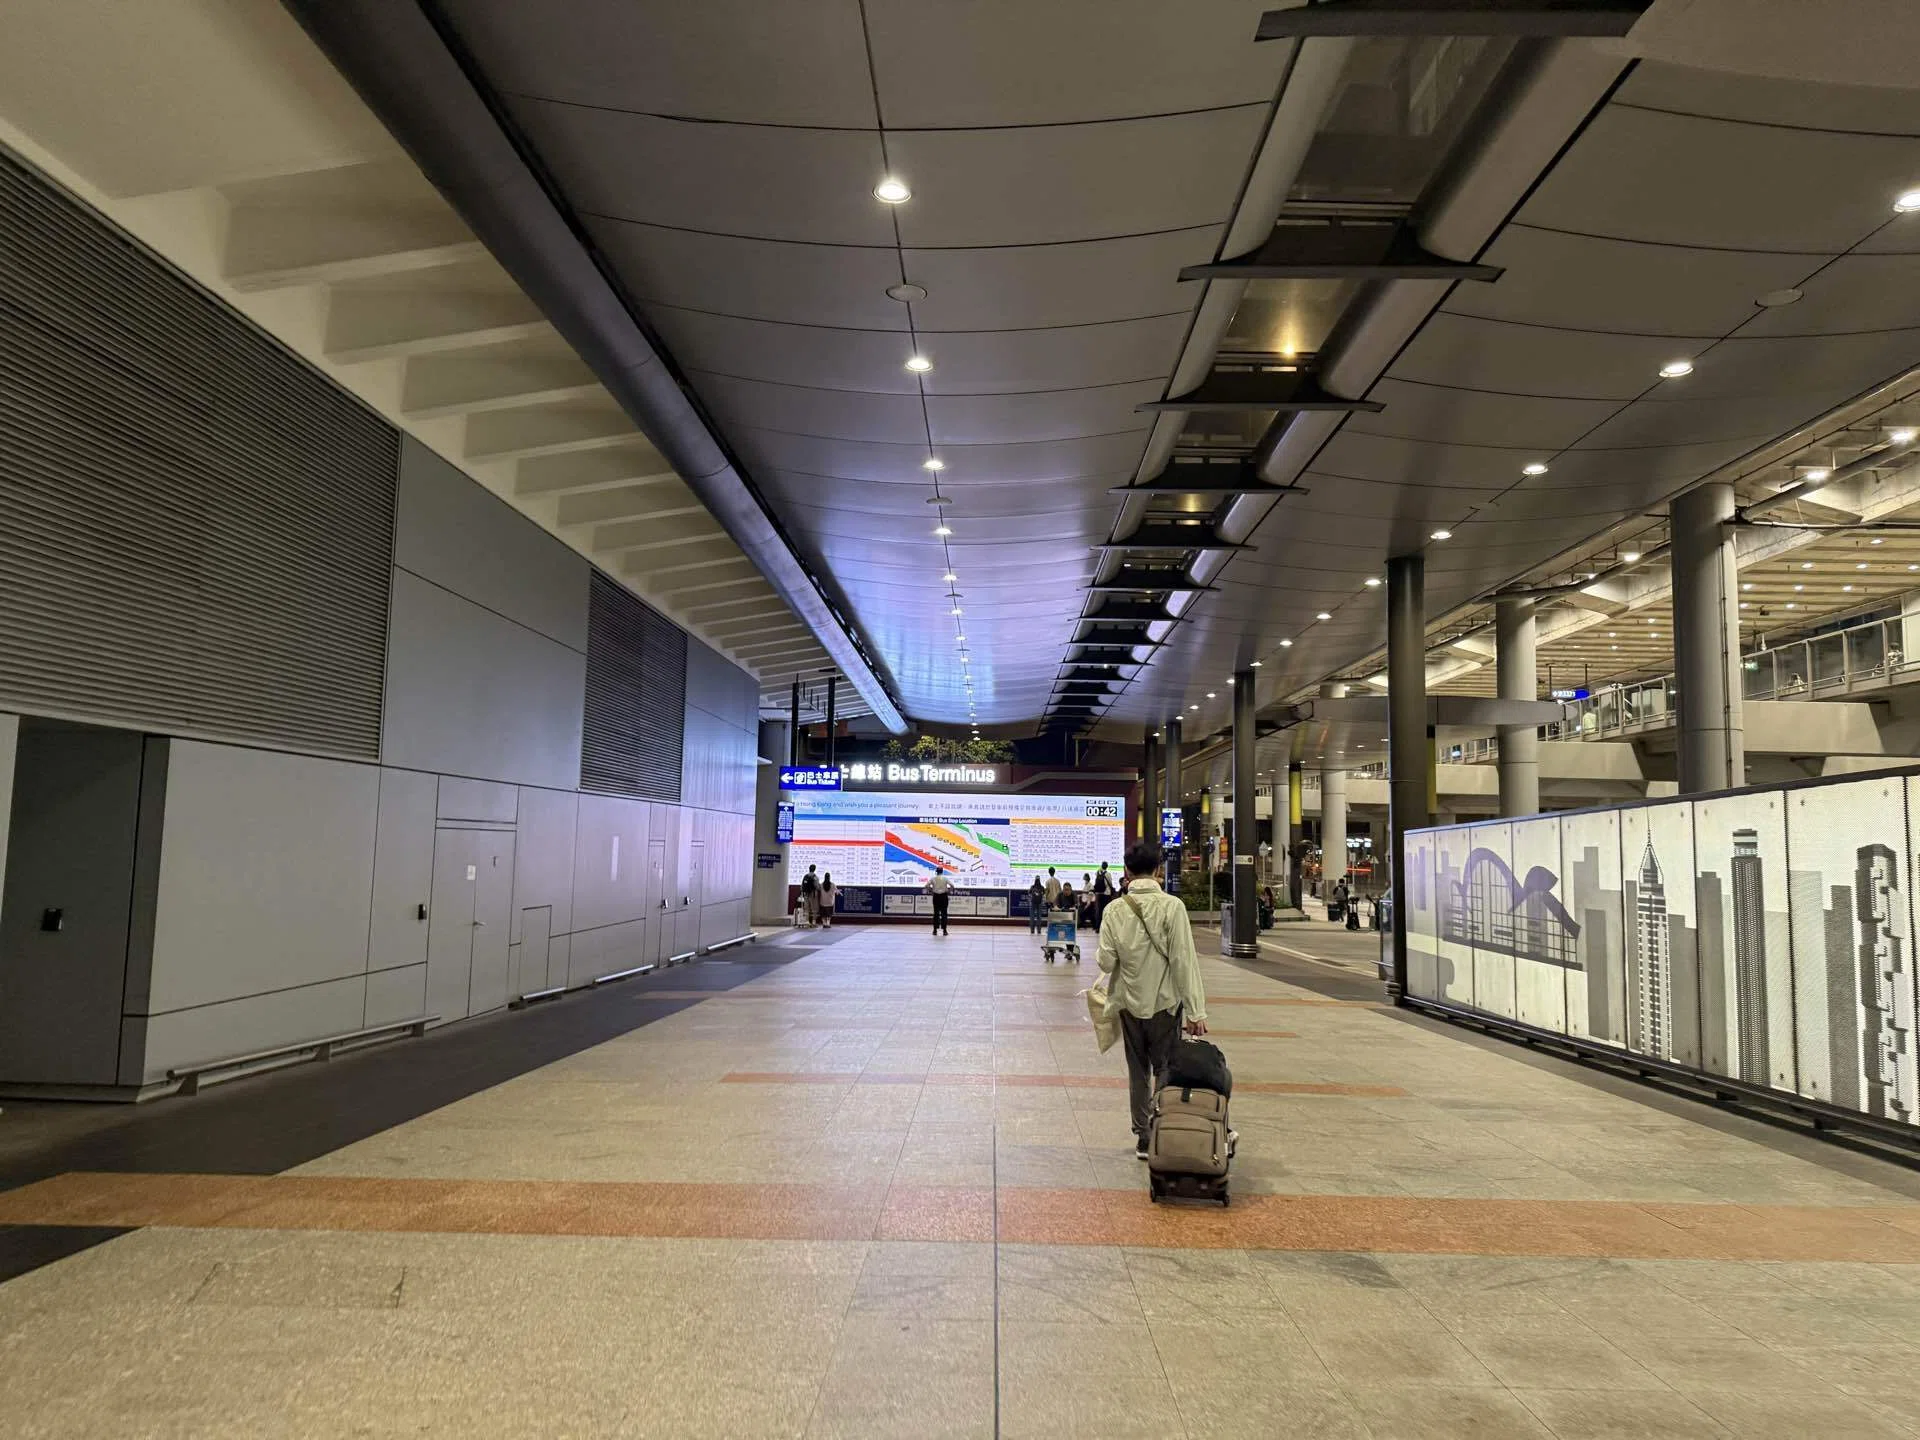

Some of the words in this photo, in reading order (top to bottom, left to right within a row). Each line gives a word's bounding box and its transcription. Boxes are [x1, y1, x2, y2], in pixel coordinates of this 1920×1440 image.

[888, 764, 920, 781] Bus
[920, 764, 995, 783] Terminus
[1087, 806, 1117, 817] 00:42
